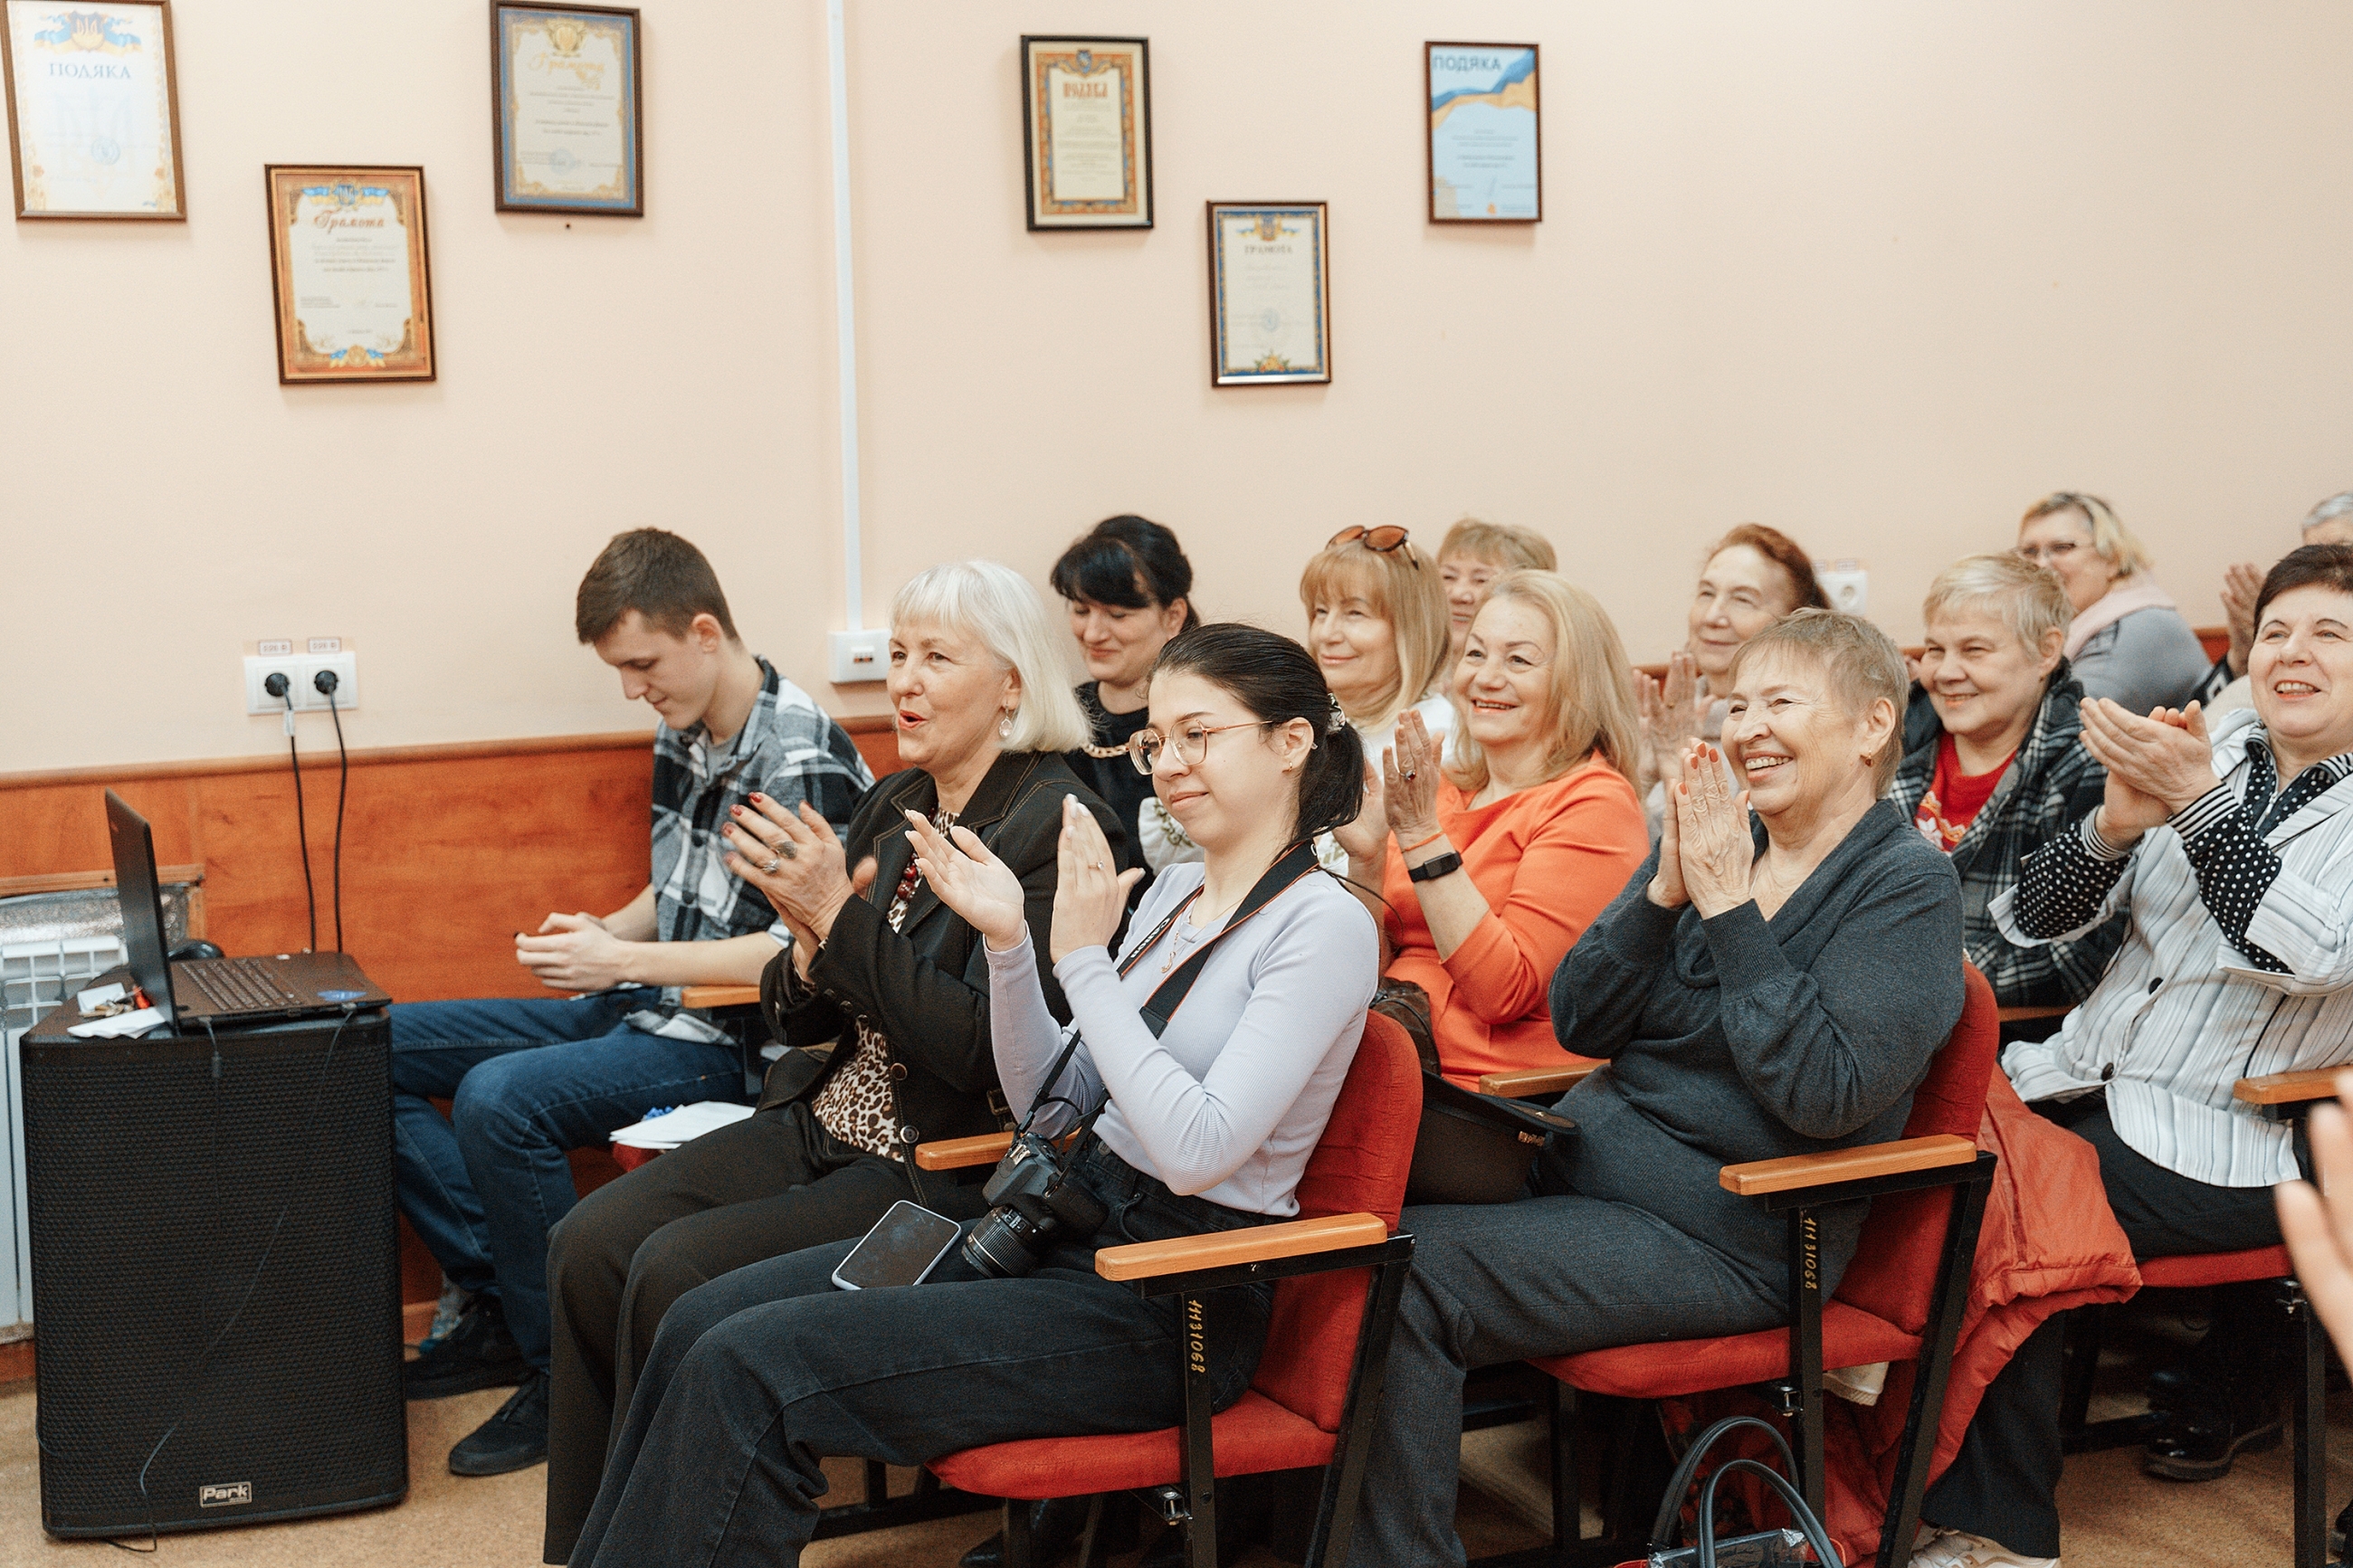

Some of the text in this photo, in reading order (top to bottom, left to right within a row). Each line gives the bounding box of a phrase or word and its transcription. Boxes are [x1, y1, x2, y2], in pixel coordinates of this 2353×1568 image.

[49, 62, 132, 80] ПОДЯКА
[1433, 53, 1502, 72] ПОДЯКА
[313, 209, 385, 234] Грамота
[1129, 917, 1171, 958] Canon
[203, 1484, 249, 1501] Park
